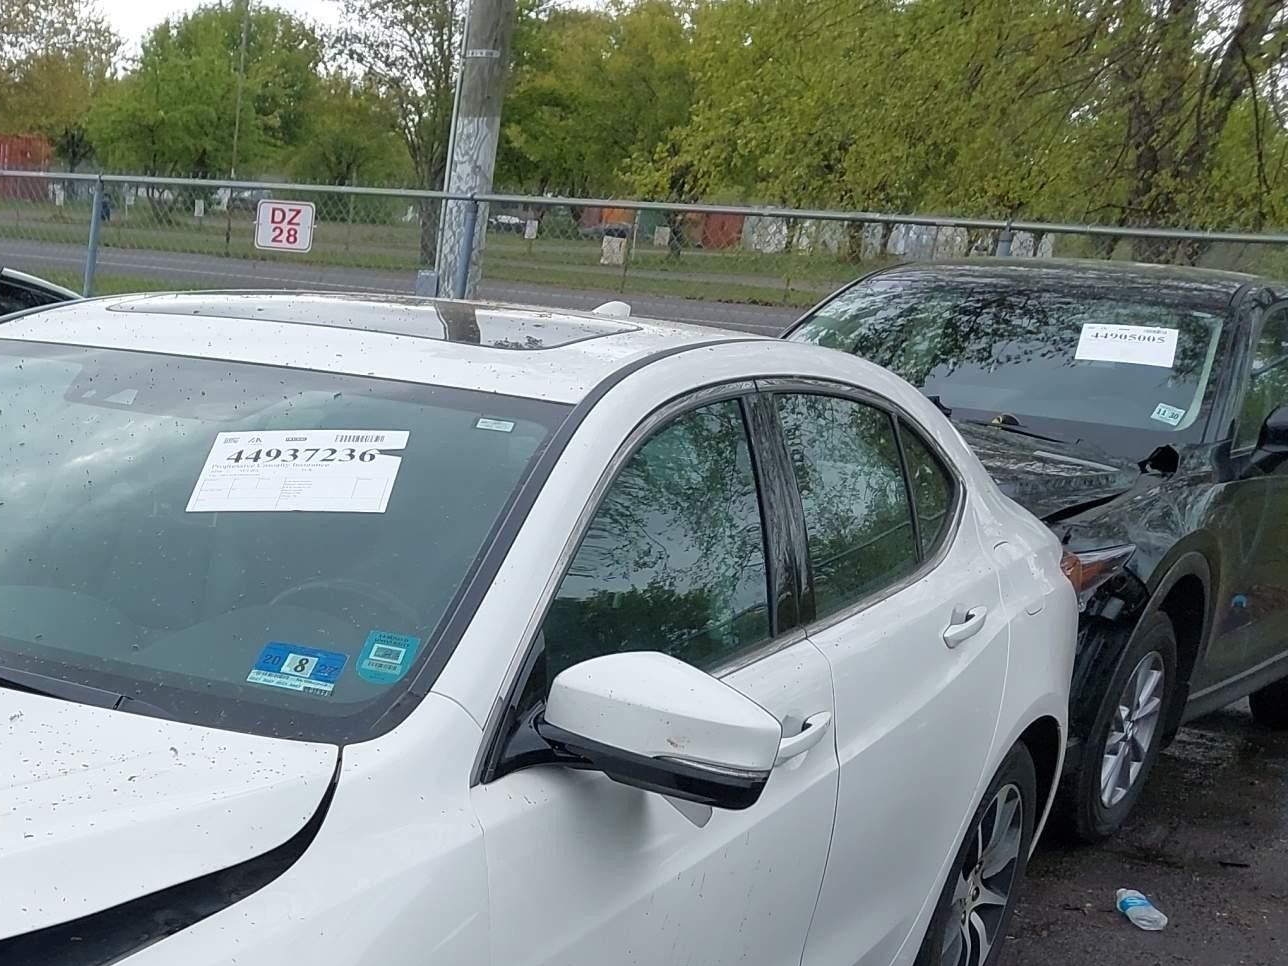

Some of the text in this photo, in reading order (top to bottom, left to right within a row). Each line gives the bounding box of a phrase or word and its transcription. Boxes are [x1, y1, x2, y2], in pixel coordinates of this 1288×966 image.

[270, 207, 302, 226] DZ
[270, 226, 298, 245] 28
[225, 447, 378, 464] 44937236
[293, 657, 310, 673] 8
